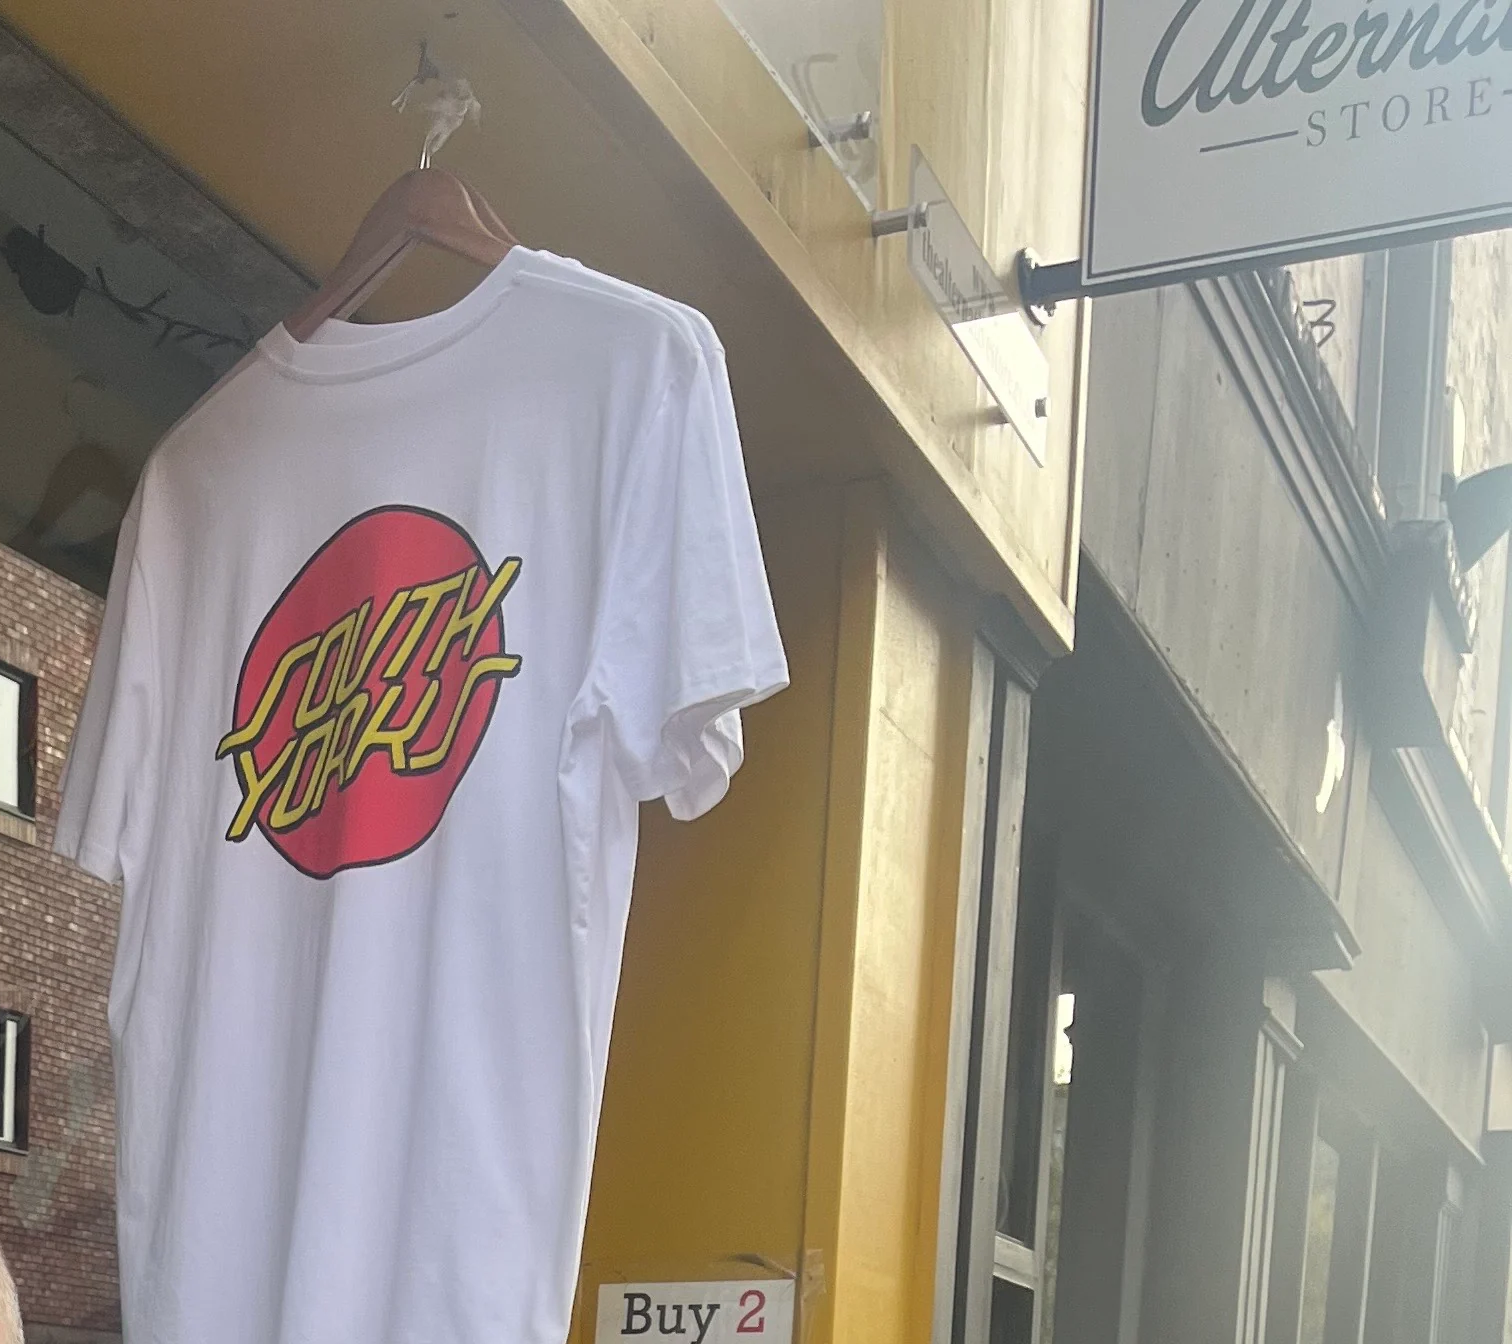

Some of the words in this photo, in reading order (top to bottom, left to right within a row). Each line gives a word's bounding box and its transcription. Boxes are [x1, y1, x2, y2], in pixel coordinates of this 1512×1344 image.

[1306, 77, 1492, 147] STORE
[215, 556, 523, 761] SOUTH
[224, 654, 523, 842] YORKS
[735, 1289, 767, 1334] 2
